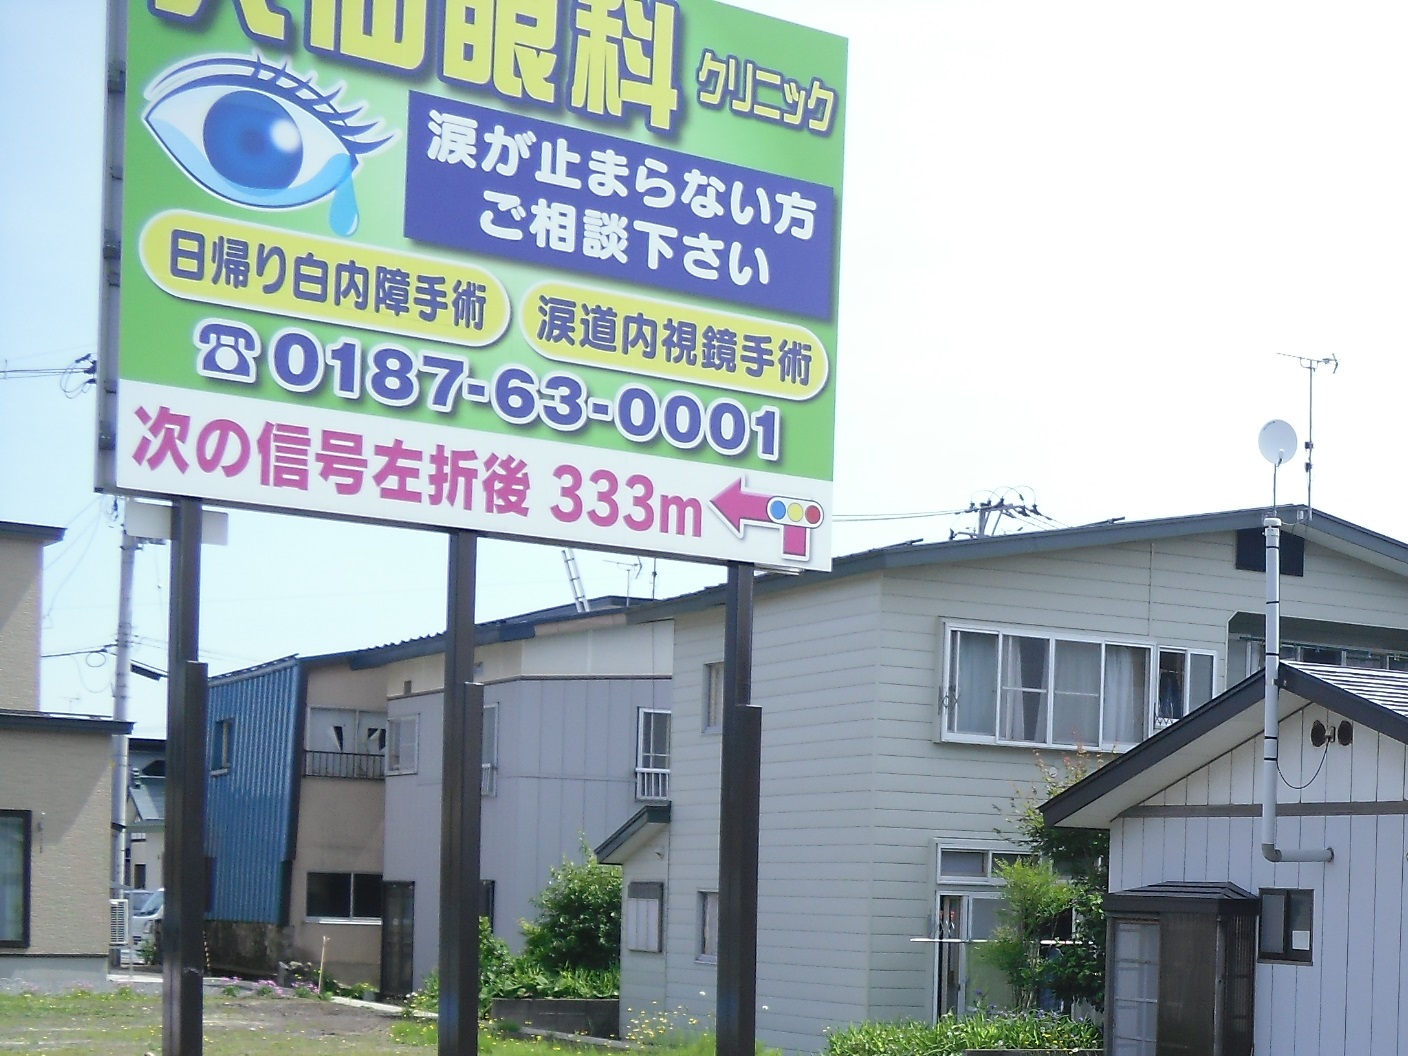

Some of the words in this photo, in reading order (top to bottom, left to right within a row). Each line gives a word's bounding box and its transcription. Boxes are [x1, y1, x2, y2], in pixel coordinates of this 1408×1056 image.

[698, 51, 835, 132] クリニック
[426, 109, 818, 240] 涙が止まらない方
[169, 228, 487, 331] 日帰り白内障手術
[479, 190, 770, 286] ご相談下さい
[536, 294, 812, 386] 涙道内視鏡手術
[271, 330, 779, 458] 0187-63-0001
[131, 405, 531, 518] 次の信号左折後
[549, 463, 703, 538] 333m
